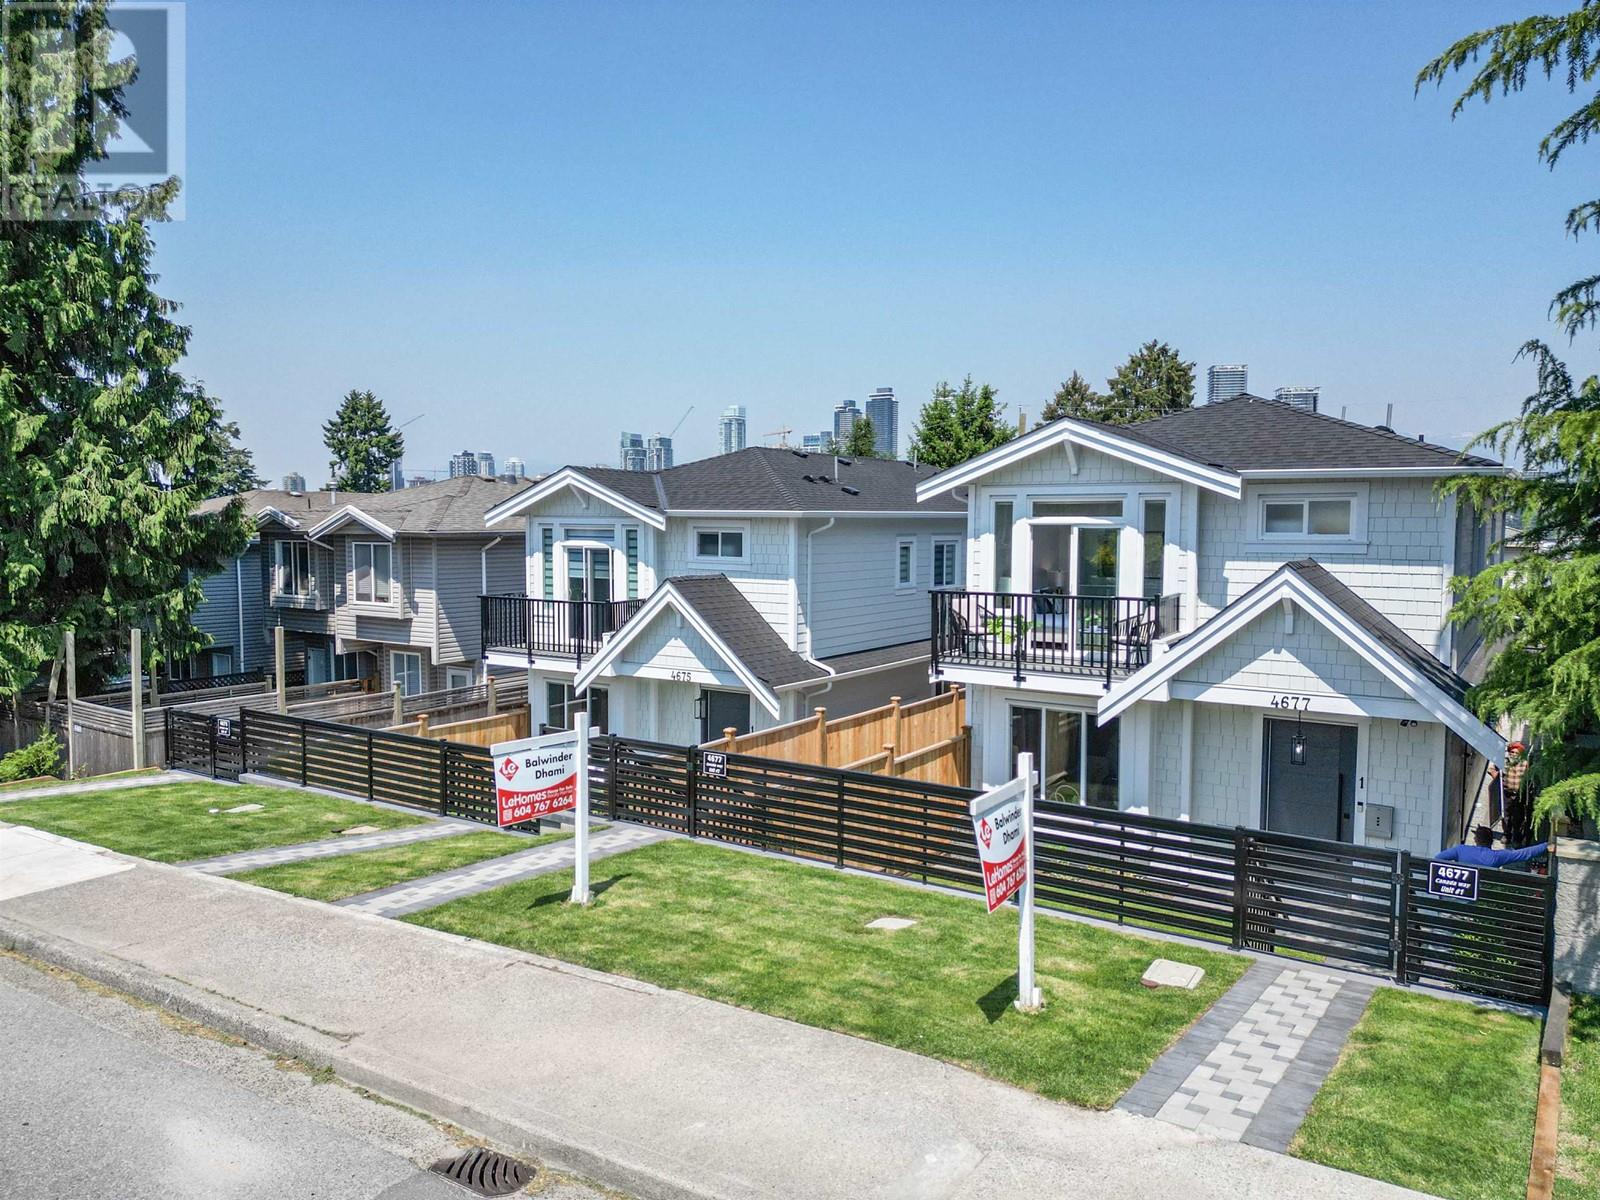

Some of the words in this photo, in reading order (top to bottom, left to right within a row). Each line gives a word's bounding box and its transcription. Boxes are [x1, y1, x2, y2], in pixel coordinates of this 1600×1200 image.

[670, 670, 691, 682] 4675
[1270, 695, 1311, 711] 4677
[525, 752, 572, 768] Balwinder
[535, 764, 564, 779] Dhami
[502, 791, 546, 808] LeHomes
[513, 805, 532, 818] 604
[534, 800, 550, 812] 767
[552, 795, 573, 808] 6264
[1438, 867, 1469, 880] 4677
[1435, 878, 1457, 886] Canada
[1441, 886, 1454, 894] Unit
